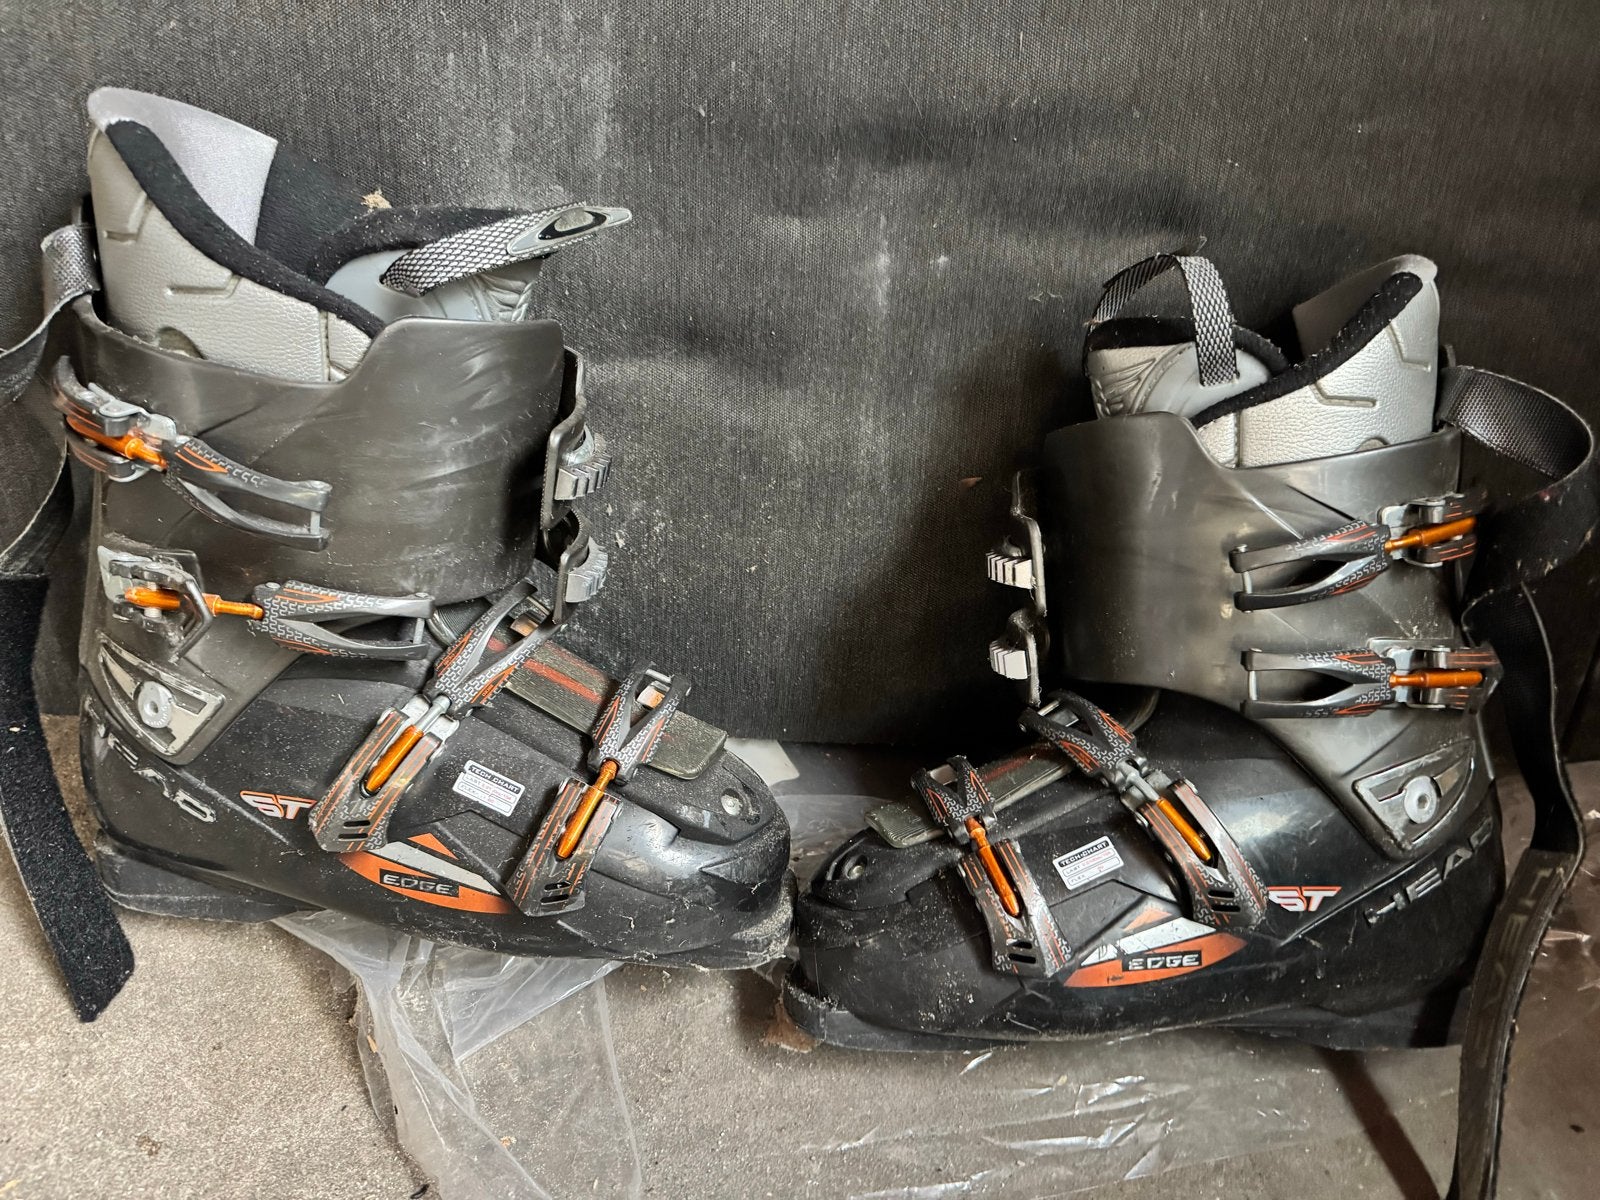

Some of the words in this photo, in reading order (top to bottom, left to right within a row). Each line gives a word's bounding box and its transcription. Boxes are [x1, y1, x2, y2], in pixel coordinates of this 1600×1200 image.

[471, 766, 492, 781] TECH
[492, 776, 520, 793] CHART
[240, 790, 318, 820] ST
[1061, 854, 1081, 866] TECH
[1081, 842, 1107, 857] CHART
[383, 873, 453, 895] EDGE
[1364, 817, 1493, 928] HEAD
[1267, 885, 1342, 912] ST
[1129, 953, 1200, 971] EDGE
